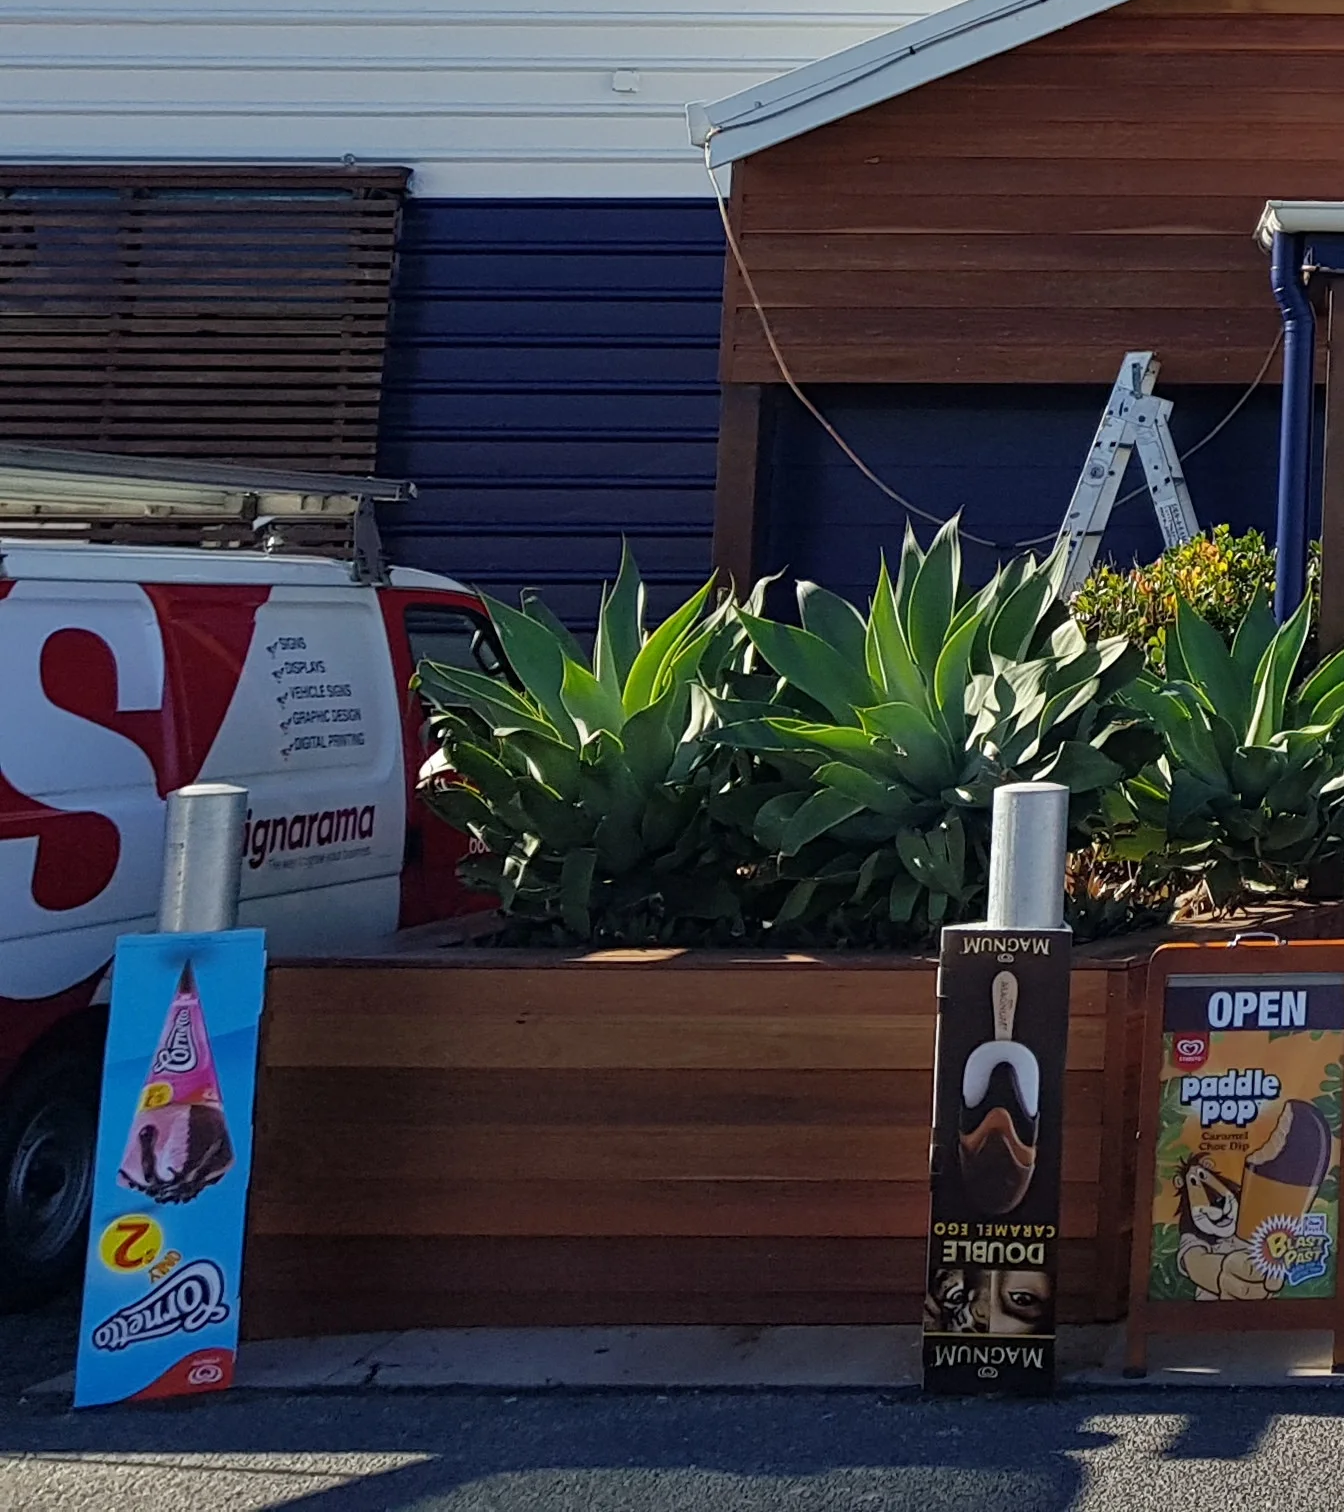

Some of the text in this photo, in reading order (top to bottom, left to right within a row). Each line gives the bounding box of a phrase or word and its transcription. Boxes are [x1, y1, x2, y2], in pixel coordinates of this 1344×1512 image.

[278, 637, 307, 651] SIGNS
[284, 660, 326, 675] DISPLAYS
[326, 684, 352, 698] SIGNS
[243, 804, 376, 870] ignarama
[964, 937, 1050, 956] MAGNUM
[1207, 990, 1307, 1028] OPEN
[1180, 1068, 1281, 1105] paddle
[1201, 1098, 1258, 1128] pop
[1201, 1132, 1248, 1140] Caramel
[1230, 1142, 1250, 1152] Dip
[934, 1222, 1056, 1238] CARAMEL EGO
[943, 1240, 1045, 1265] DOUBLE
[92, 1258, 230, 1352] Cornetto
[935, 1345, 1044, 1369] MAGNUM
